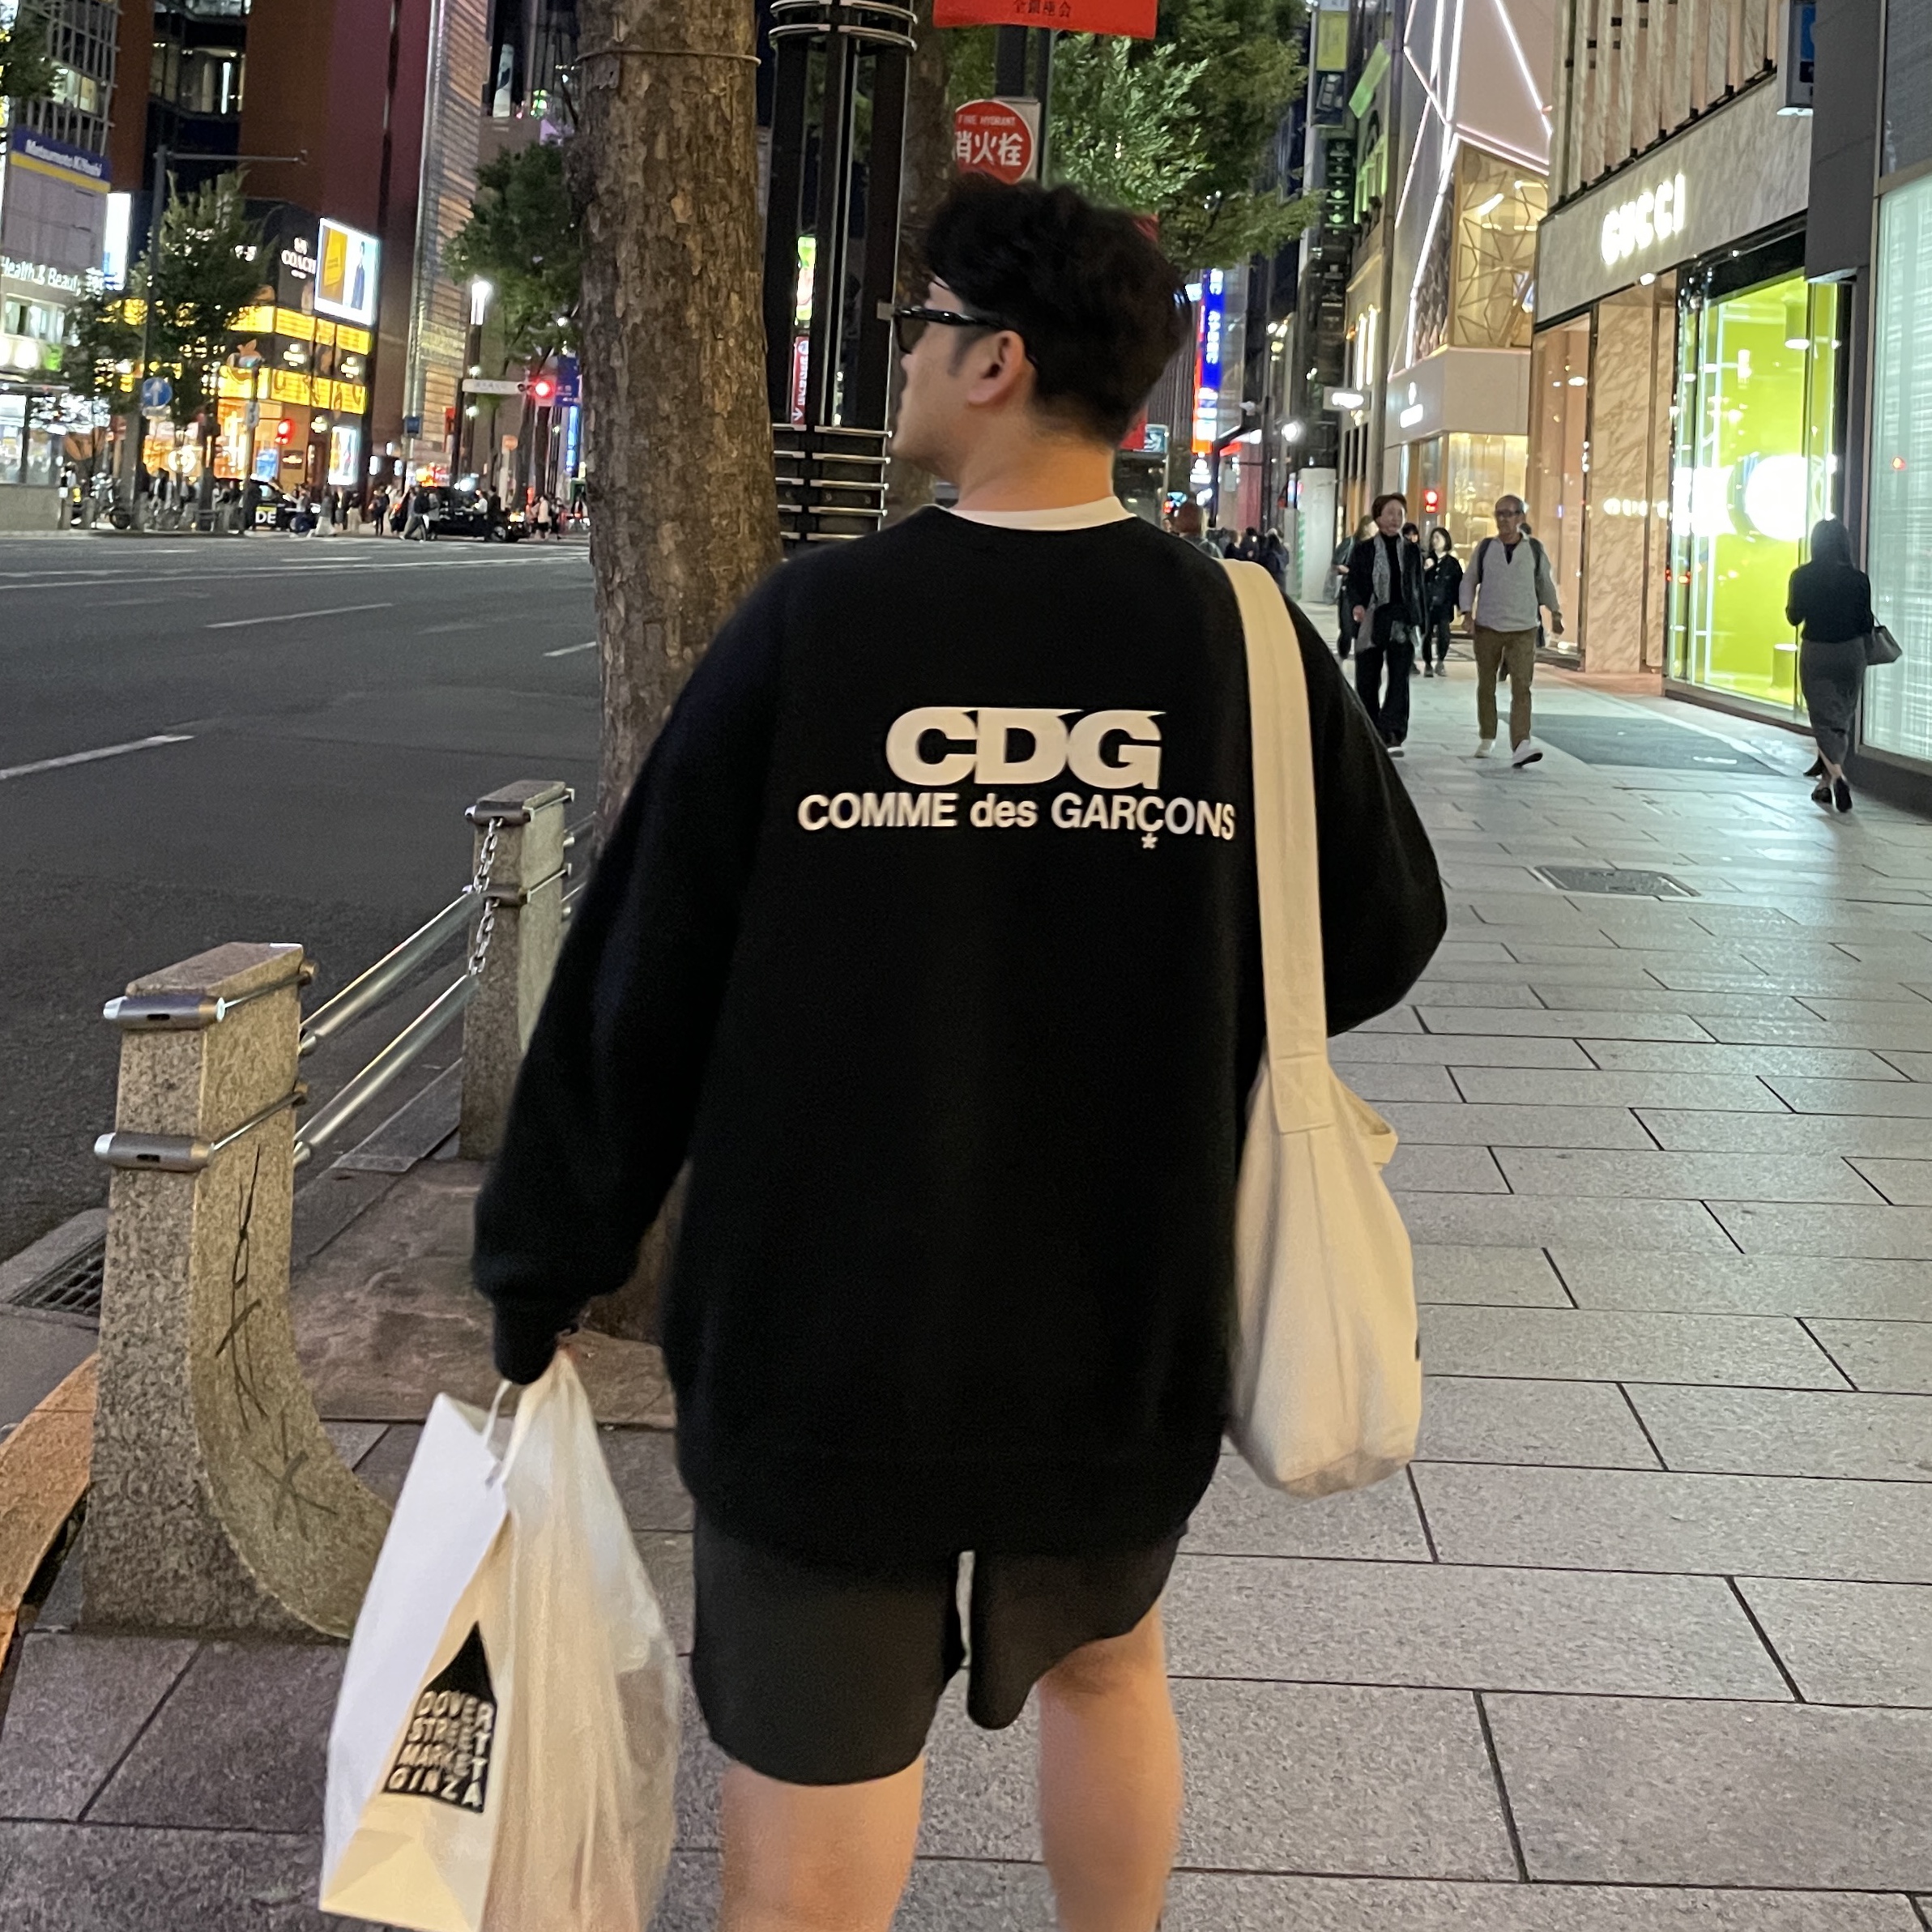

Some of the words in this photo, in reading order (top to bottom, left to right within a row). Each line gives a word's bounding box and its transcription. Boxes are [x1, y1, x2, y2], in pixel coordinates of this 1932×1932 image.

[1601, 171, 1686, 267] GUCCI
[885, 706, 1166, 790] CDG
[798, 792, 958, 831] COMME
[970, 793, 1038, 828] des
[1051, 793, 1236, 849] GARÇONS
[418, 1691, 493, 1730] DOVER
[407, 1717, 491, 1756] STREET
[397, 1743, 488, 1781] MARKET
[387, 1768, 484, 1807] GINZA
